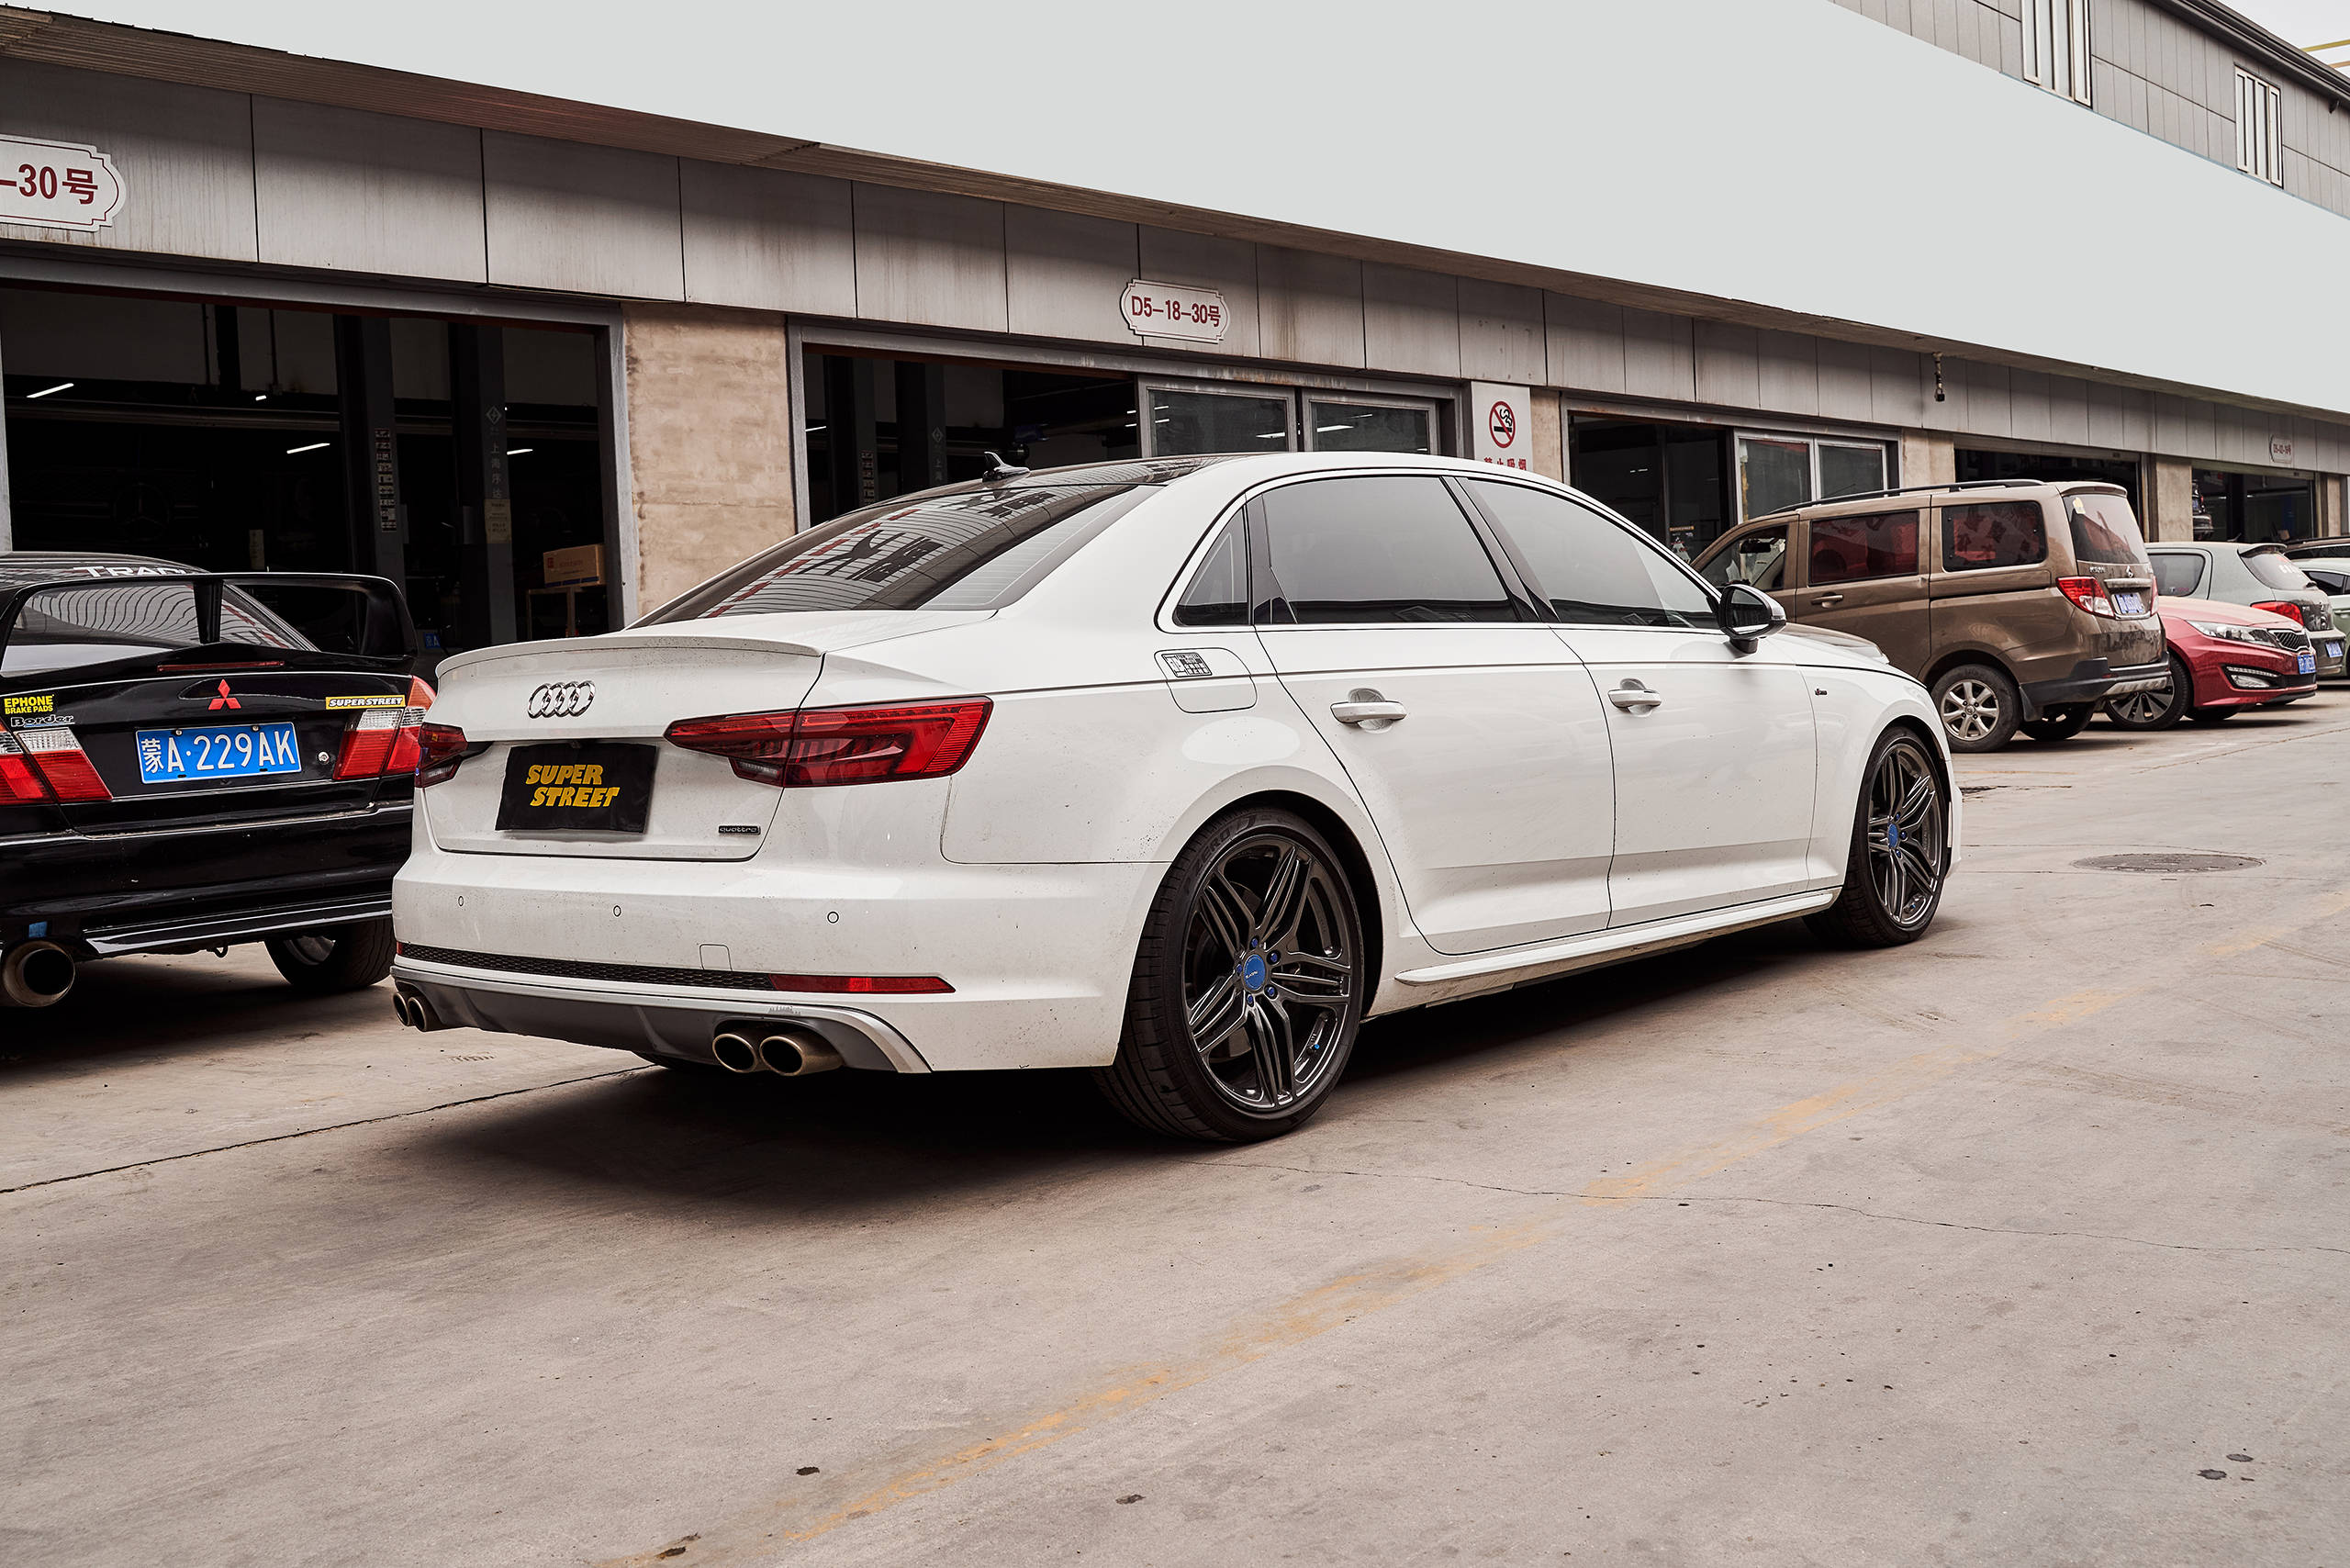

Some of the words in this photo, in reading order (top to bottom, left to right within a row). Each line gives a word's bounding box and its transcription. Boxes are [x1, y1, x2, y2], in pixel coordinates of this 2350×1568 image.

[4, 695, 54, 708] EPHONE
[5, 706, 32, 715] BRAKE
[32, 705, 54, 713] PADS
[525, 764, 604, 786] SUPER
[530, 786, 621, 809] STREET
